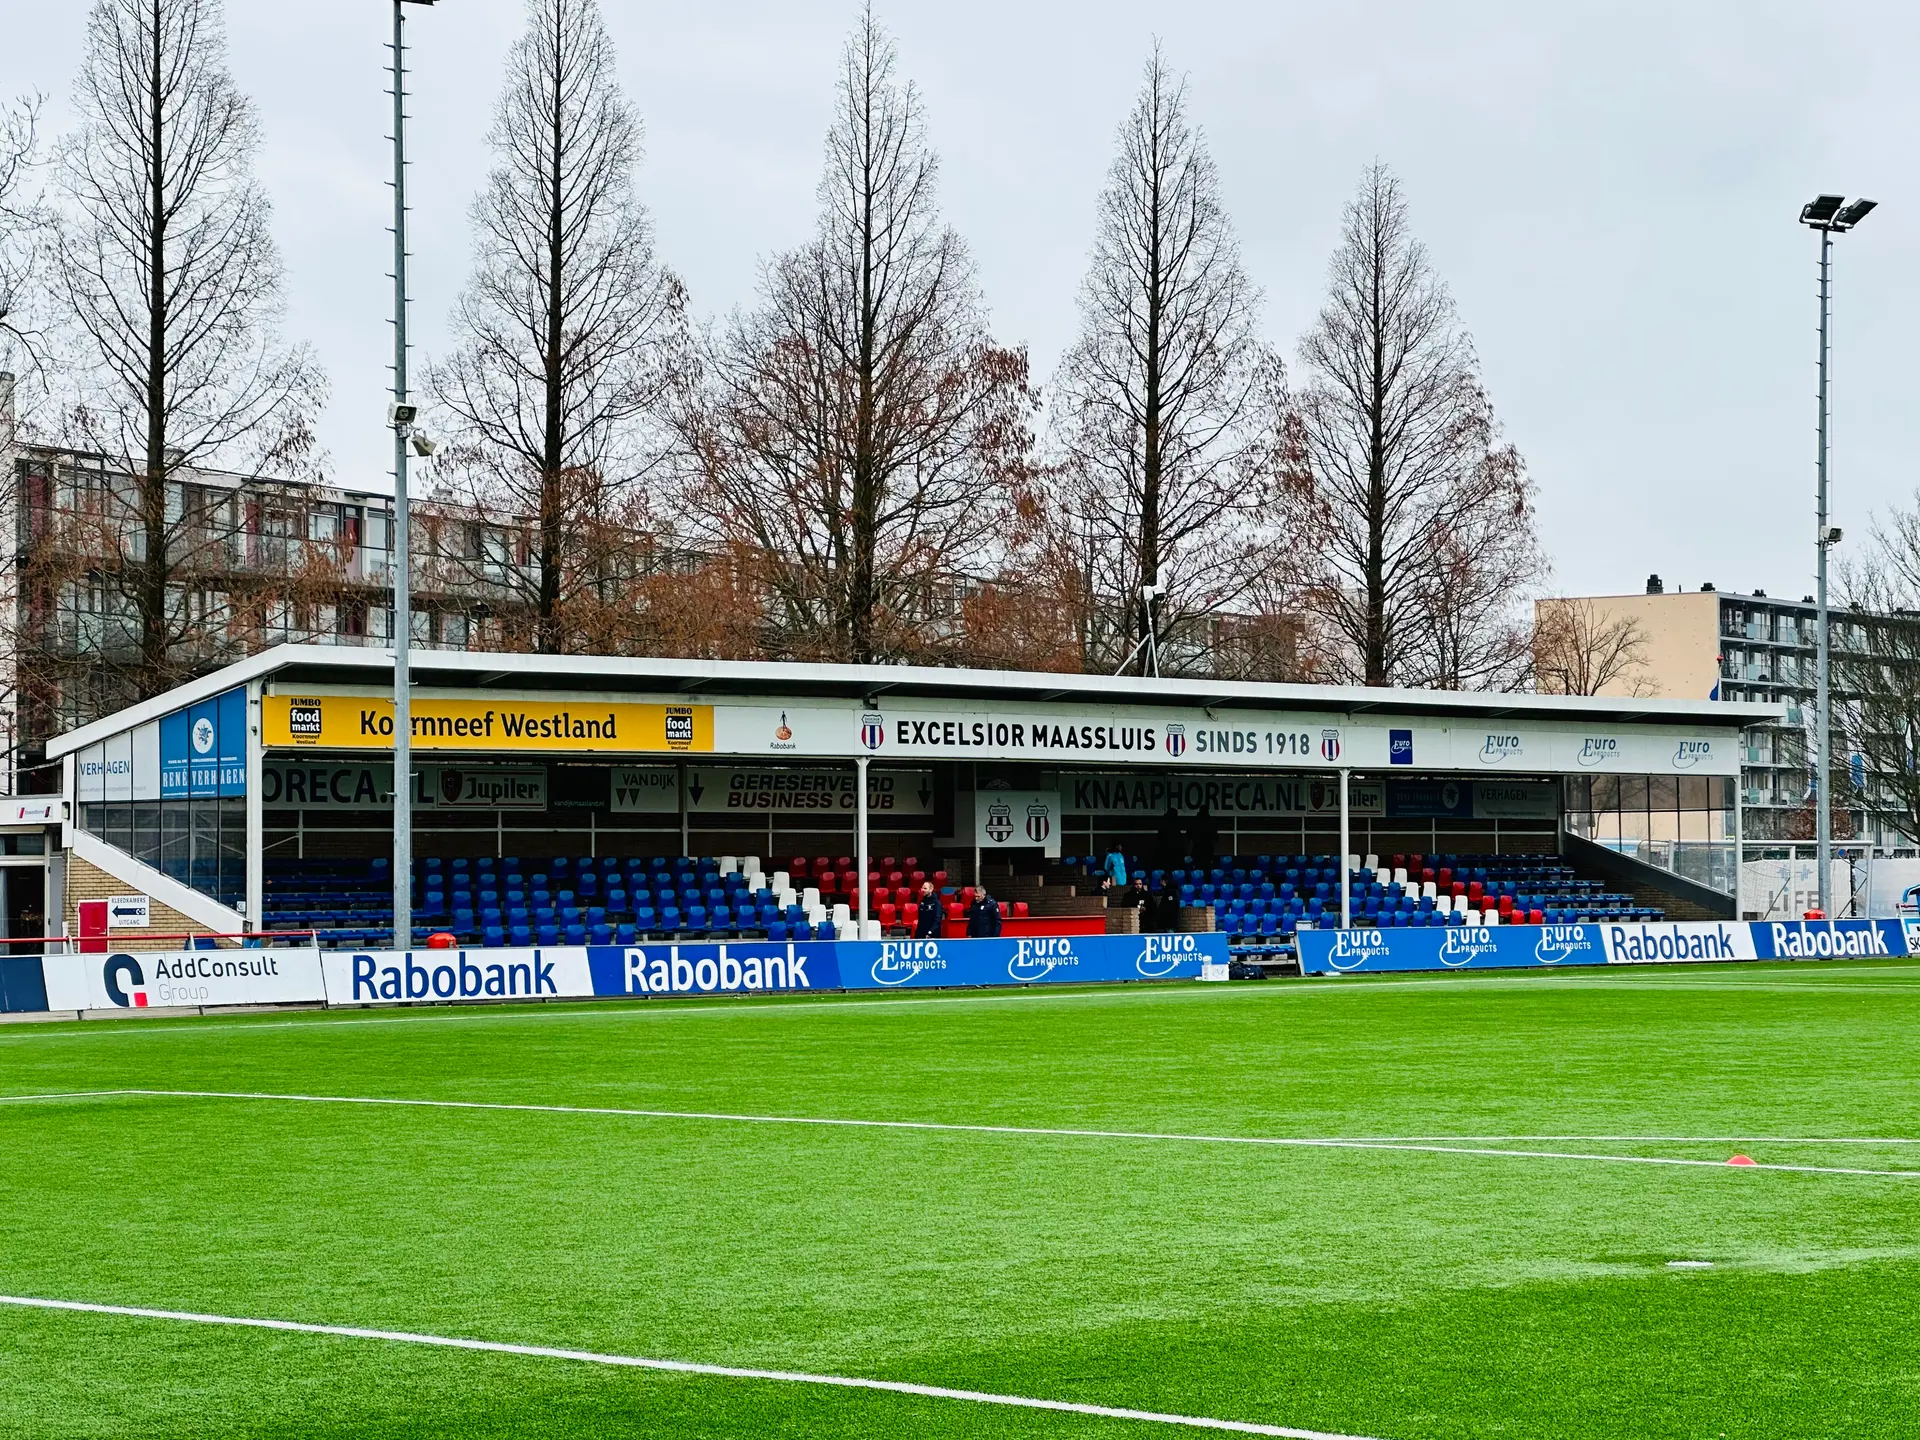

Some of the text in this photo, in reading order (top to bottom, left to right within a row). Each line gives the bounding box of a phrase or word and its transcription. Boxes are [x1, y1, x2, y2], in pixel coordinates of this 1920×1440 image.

[290, 698, 321, 706] JUMBO
[666, 707, 692, 715] JUMBO
[291, 710, 320, 722] food
[361, 710, 617, 738] Kornneef Westland
[666, 717, 691, 730] food
[292, 722, 320, 732] markt
[666, 730, 692, 739] markt
[897, 721, 1155, 750] EXCELSIOR MAASSLUIS
[770, 742, 796, 750] Rabobank
[1196, 730, 1310, 755] SINDS 1918
[1485, 735, 1520, 754] Euro
[1583, 738, 1616, 757] Euro
[1678, 741, 1710, 760] Euro
[1495, 748, 1524, 756] PRODUCTS
[1688, 752, 1714, 760] PRODUCTS
[80, 760, 130, 776] VERHAGEN
[162, 768, 245, 788] RENÉ VERHAGEN
[622, 773, 675, 790] VAN DIJK
[730, 774, 895, 792] GERESERVERD
[465, 777, 539, 805] Jupiler
[1075, 779, 1306, 812] KNAAPHORECA.NL
[1480, 788, 1528, 800] VERHAGEN
[728, 792, 895, 810] BUSINESS CUB
[1335, 931, 1382, 958] Euro
[1446, 928, 1490, 954] Euro
[1541, 926, 1584, 951] Euro
[1556, 942, 1591, 950] PRODUCTS
[1612, 924, 1734, 961] Rabobank
[1772, 920, 1889, 957] Rabobank
[880, 941, 939, 970] Euro
[1017, 938, 1070, 968] Euro
[1144, 935, 1197, 963] Euro
[1161, 952, 1202, 962] PRODUCTS
[1352, 947, 1390, 956] PRODUCTS
[1461, 944, 1498, 953] PRODUCTS
[156, 956, 278, 980] AddConsult
[624, 944, 810, 993] Rabobank
[900, 959, 947, 970] PRODUCTS
[1034, 956, 1080, 966] PRODUCTS
[352, 950, 558, 1001] Rabobank
[159, 984, 208, 1002] Group
